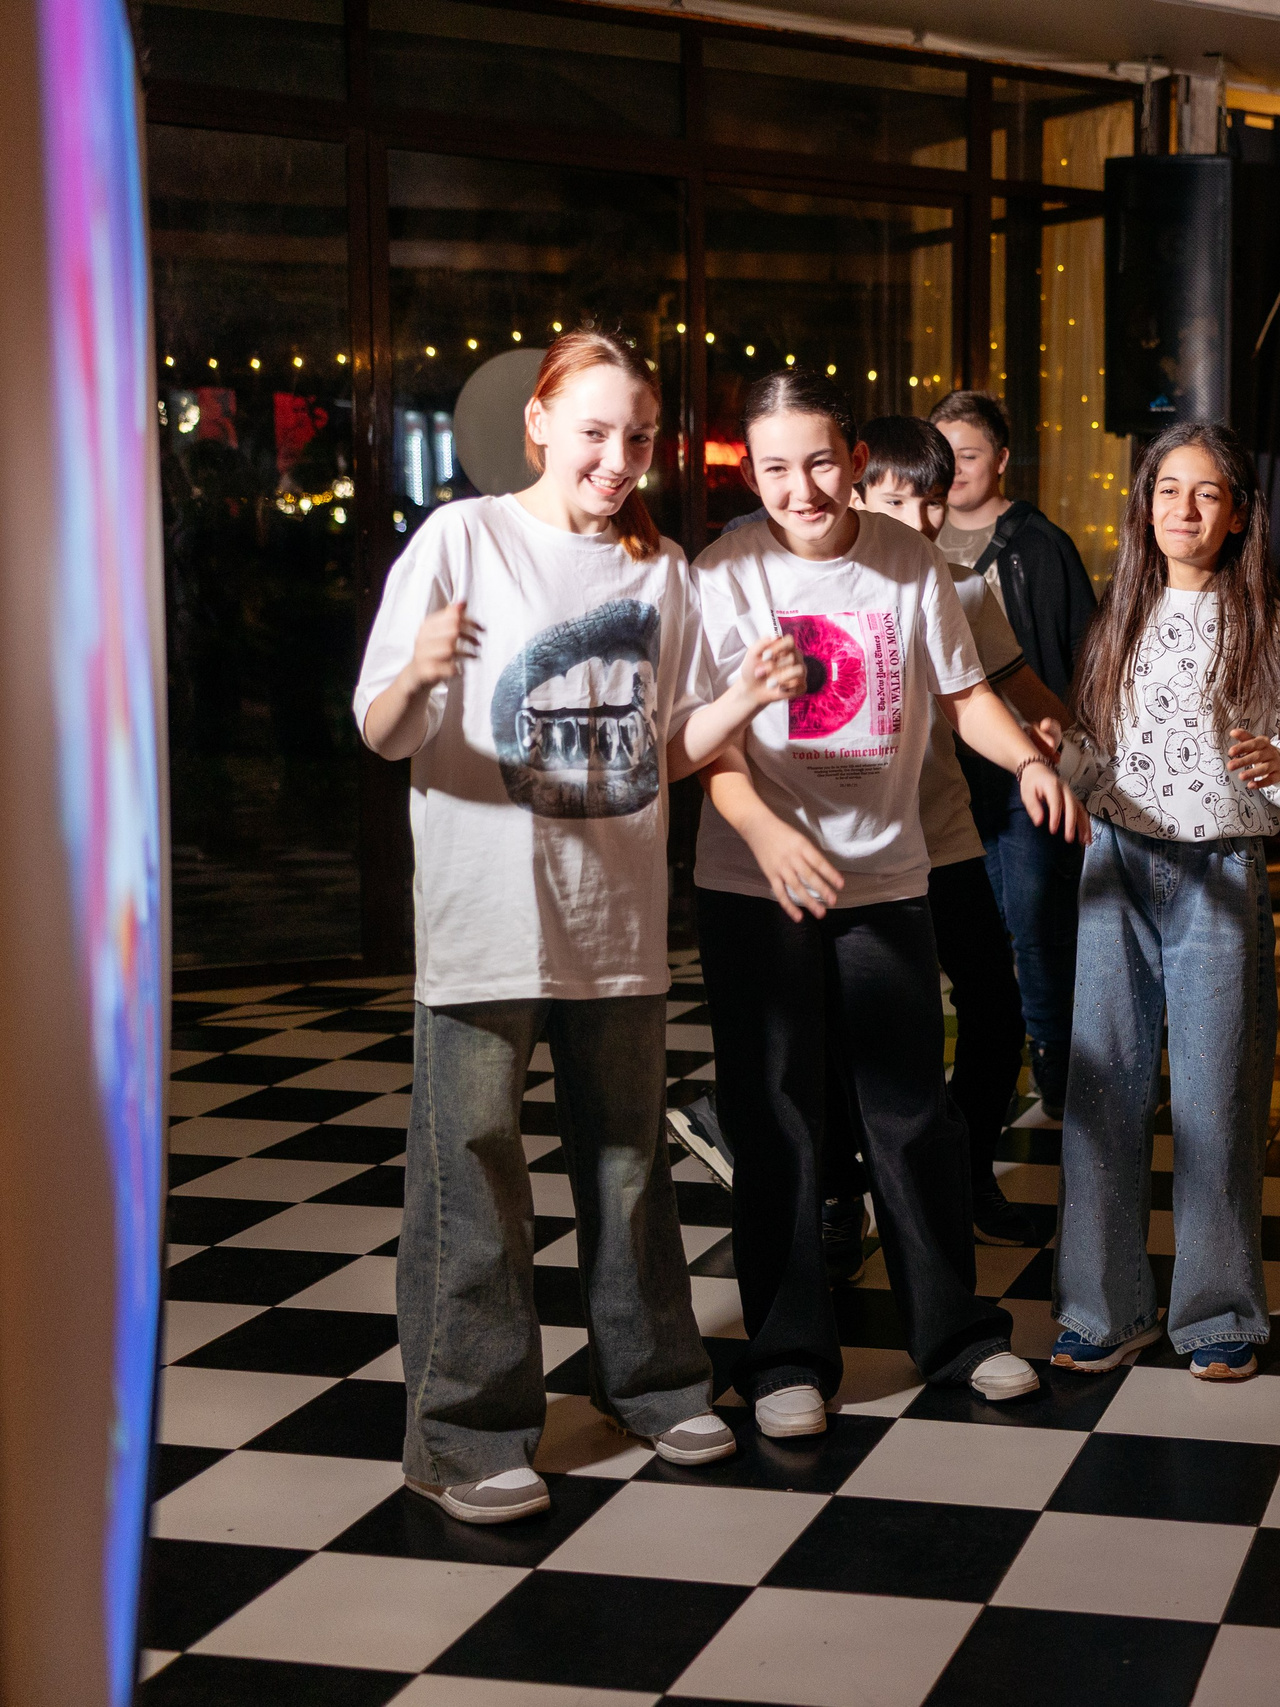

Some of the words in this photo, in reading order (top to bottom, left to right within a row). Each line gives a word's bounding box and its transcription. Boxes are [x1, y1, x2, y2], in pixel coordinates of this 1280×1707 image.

[882, 612, 897, 645] MOON
[874, 635, 883, 658] Times
[889, 649, 900, 666] ON
[876, 659, 887, 679] York
[877, 680, 886, 696] New
[891, 670, 901, 704] WALK
[878, 697, 887, 711] The
[892, 707, 902, 733] MEN
[792, 749, 820, 760] road
[824, 748, 836, 759] to
